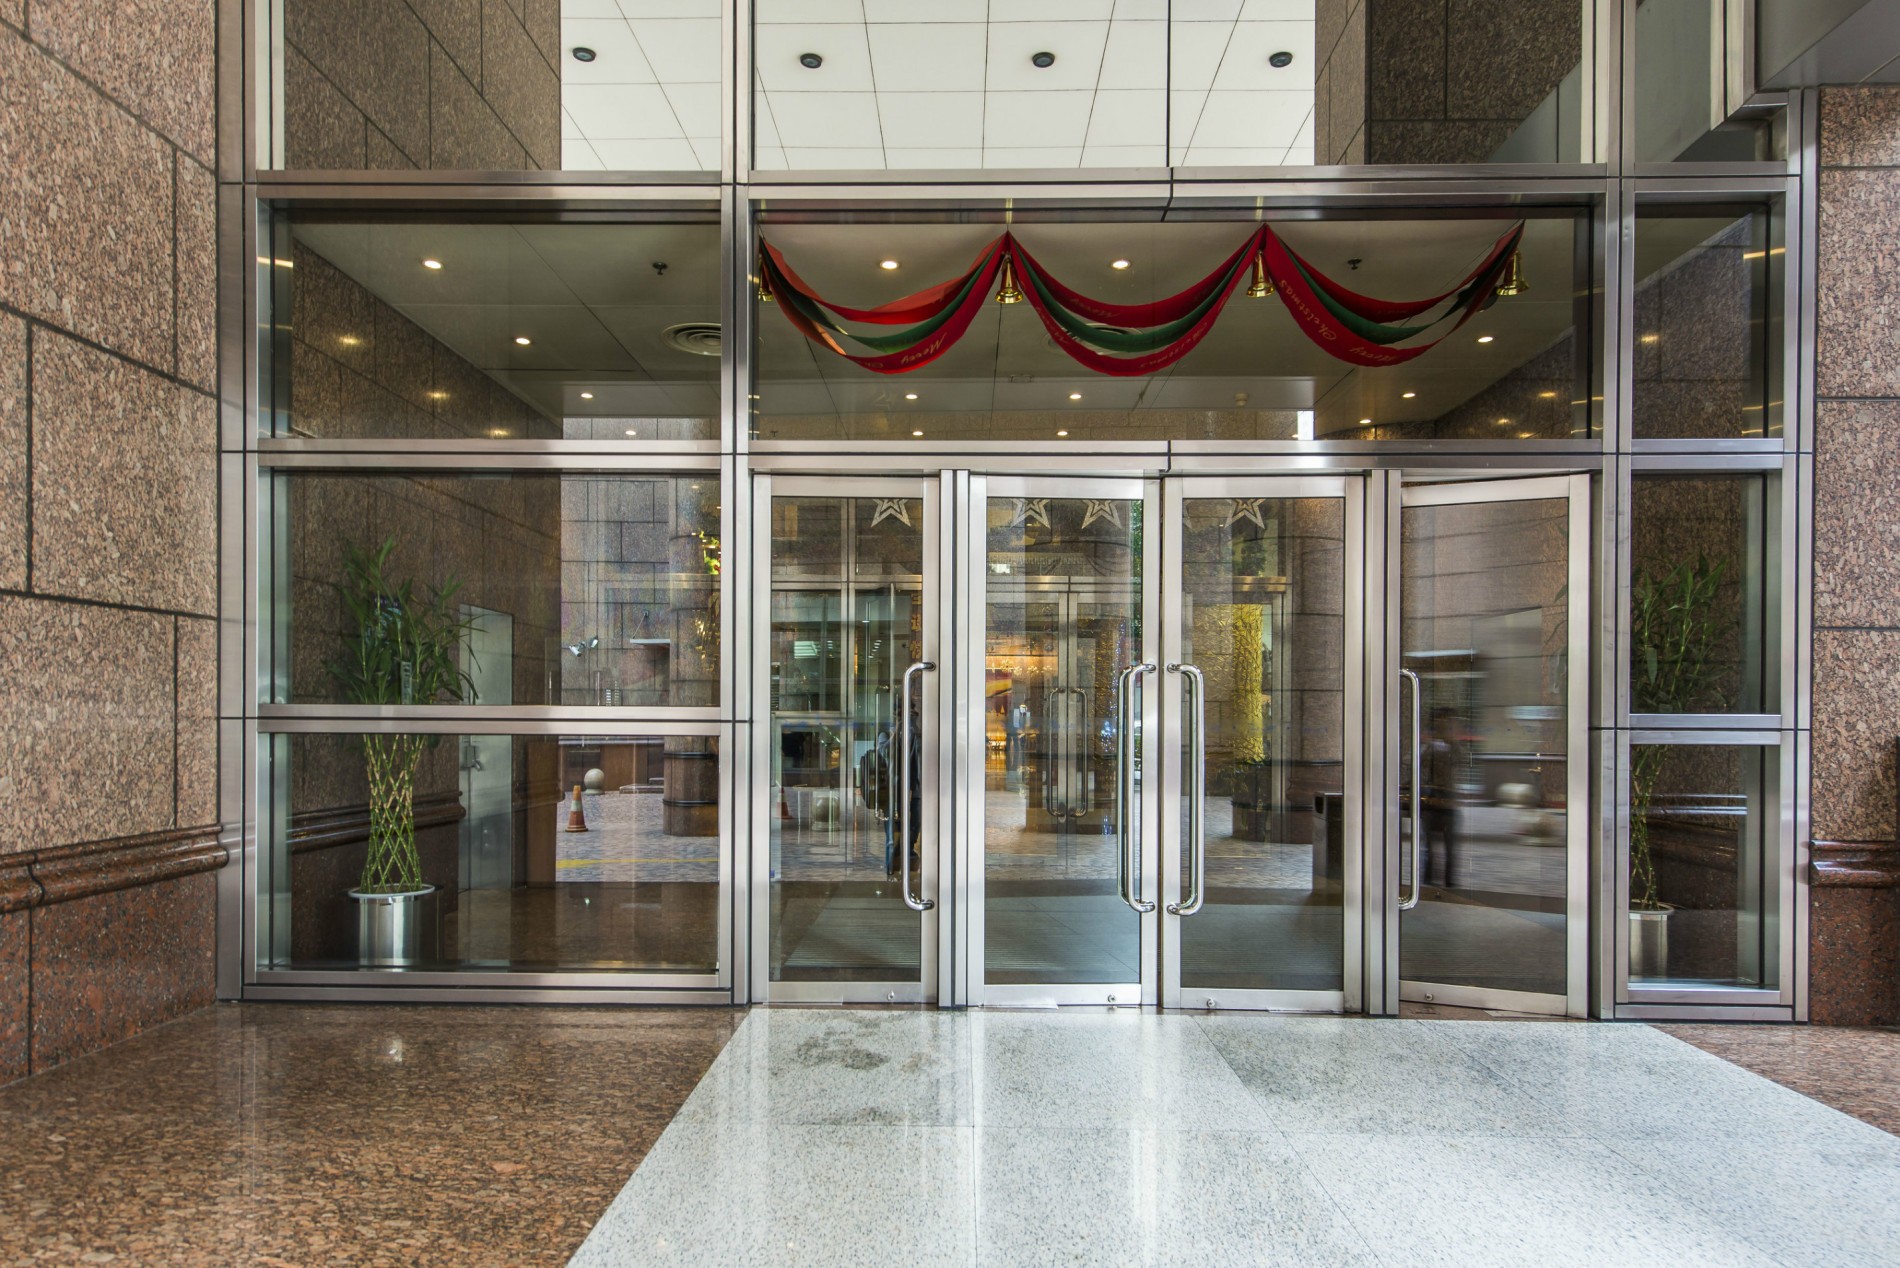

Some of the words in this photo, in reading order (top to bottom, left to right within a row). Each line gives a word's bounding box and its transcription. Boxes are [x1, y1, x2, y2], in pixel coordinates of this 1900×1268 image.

[1279, 279, 1337, 341] Christmas
[901, 332, 947, 364] Merry
[1348, 347, 1397, 362] Merry
